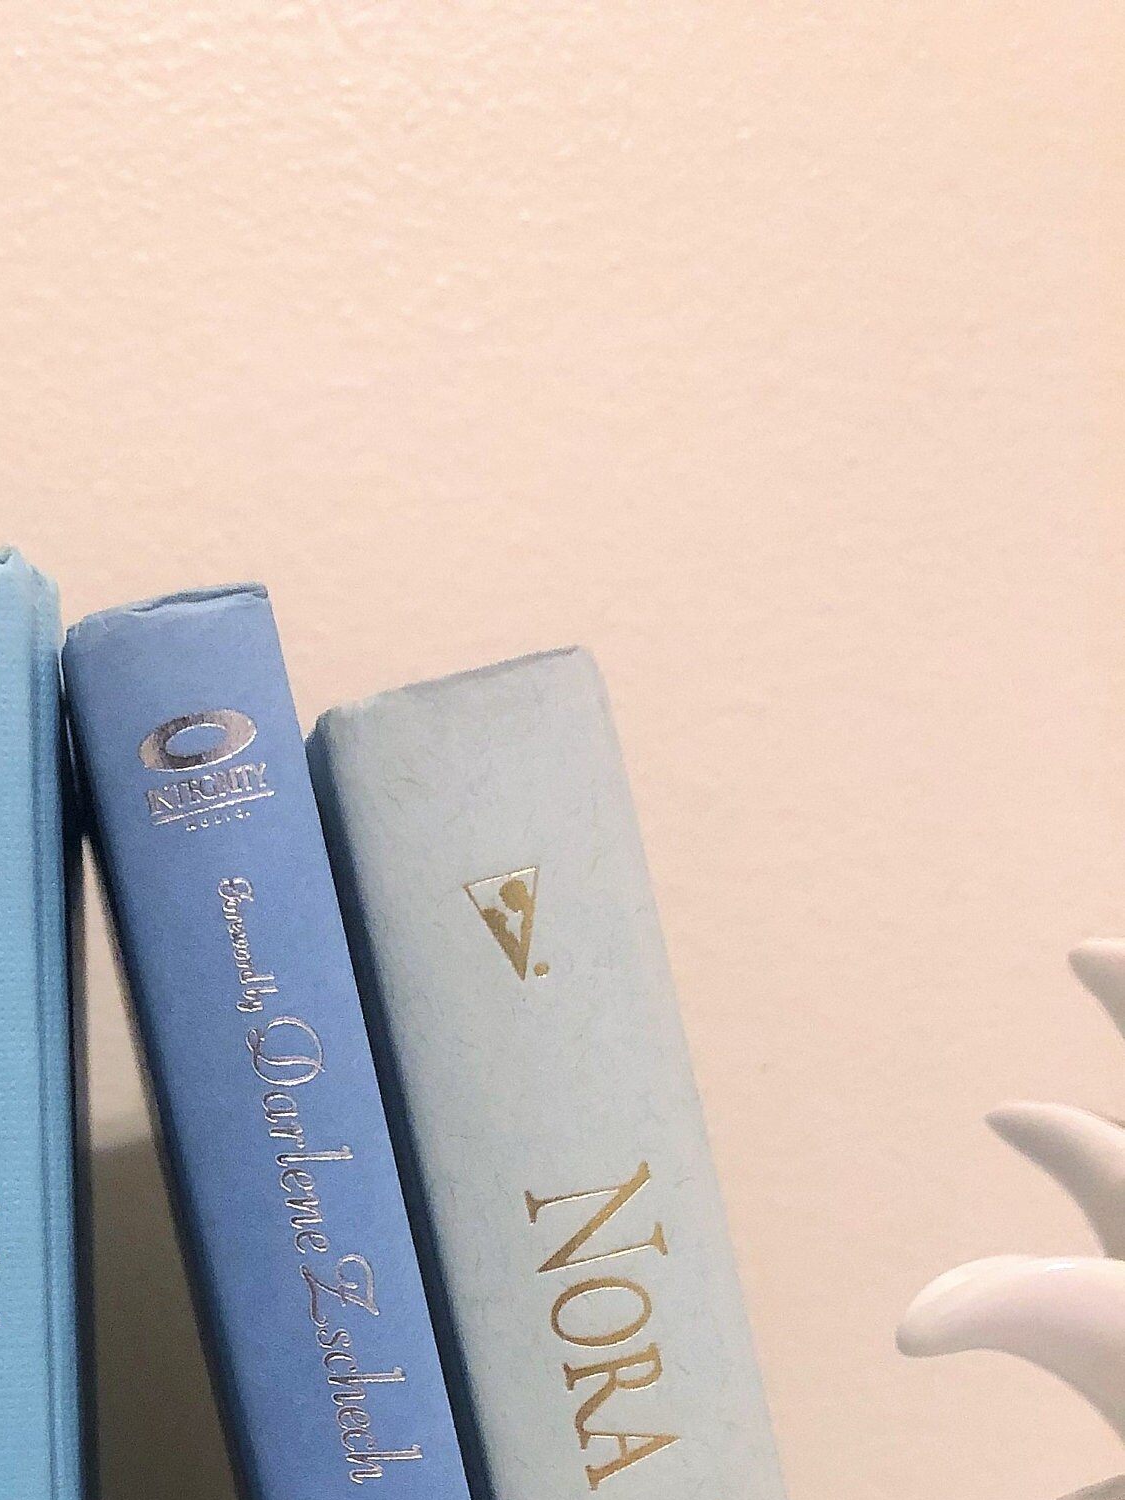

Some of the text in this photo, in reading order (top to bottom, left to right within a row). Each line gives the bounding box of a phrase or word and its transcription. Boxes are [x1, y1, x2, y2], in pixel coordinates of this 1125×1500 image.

[245, 1016, 354, 1255] Darlene
[299, 1252, 425, 1486] Zschech
[523, 1160, 681, 1492] NORA
